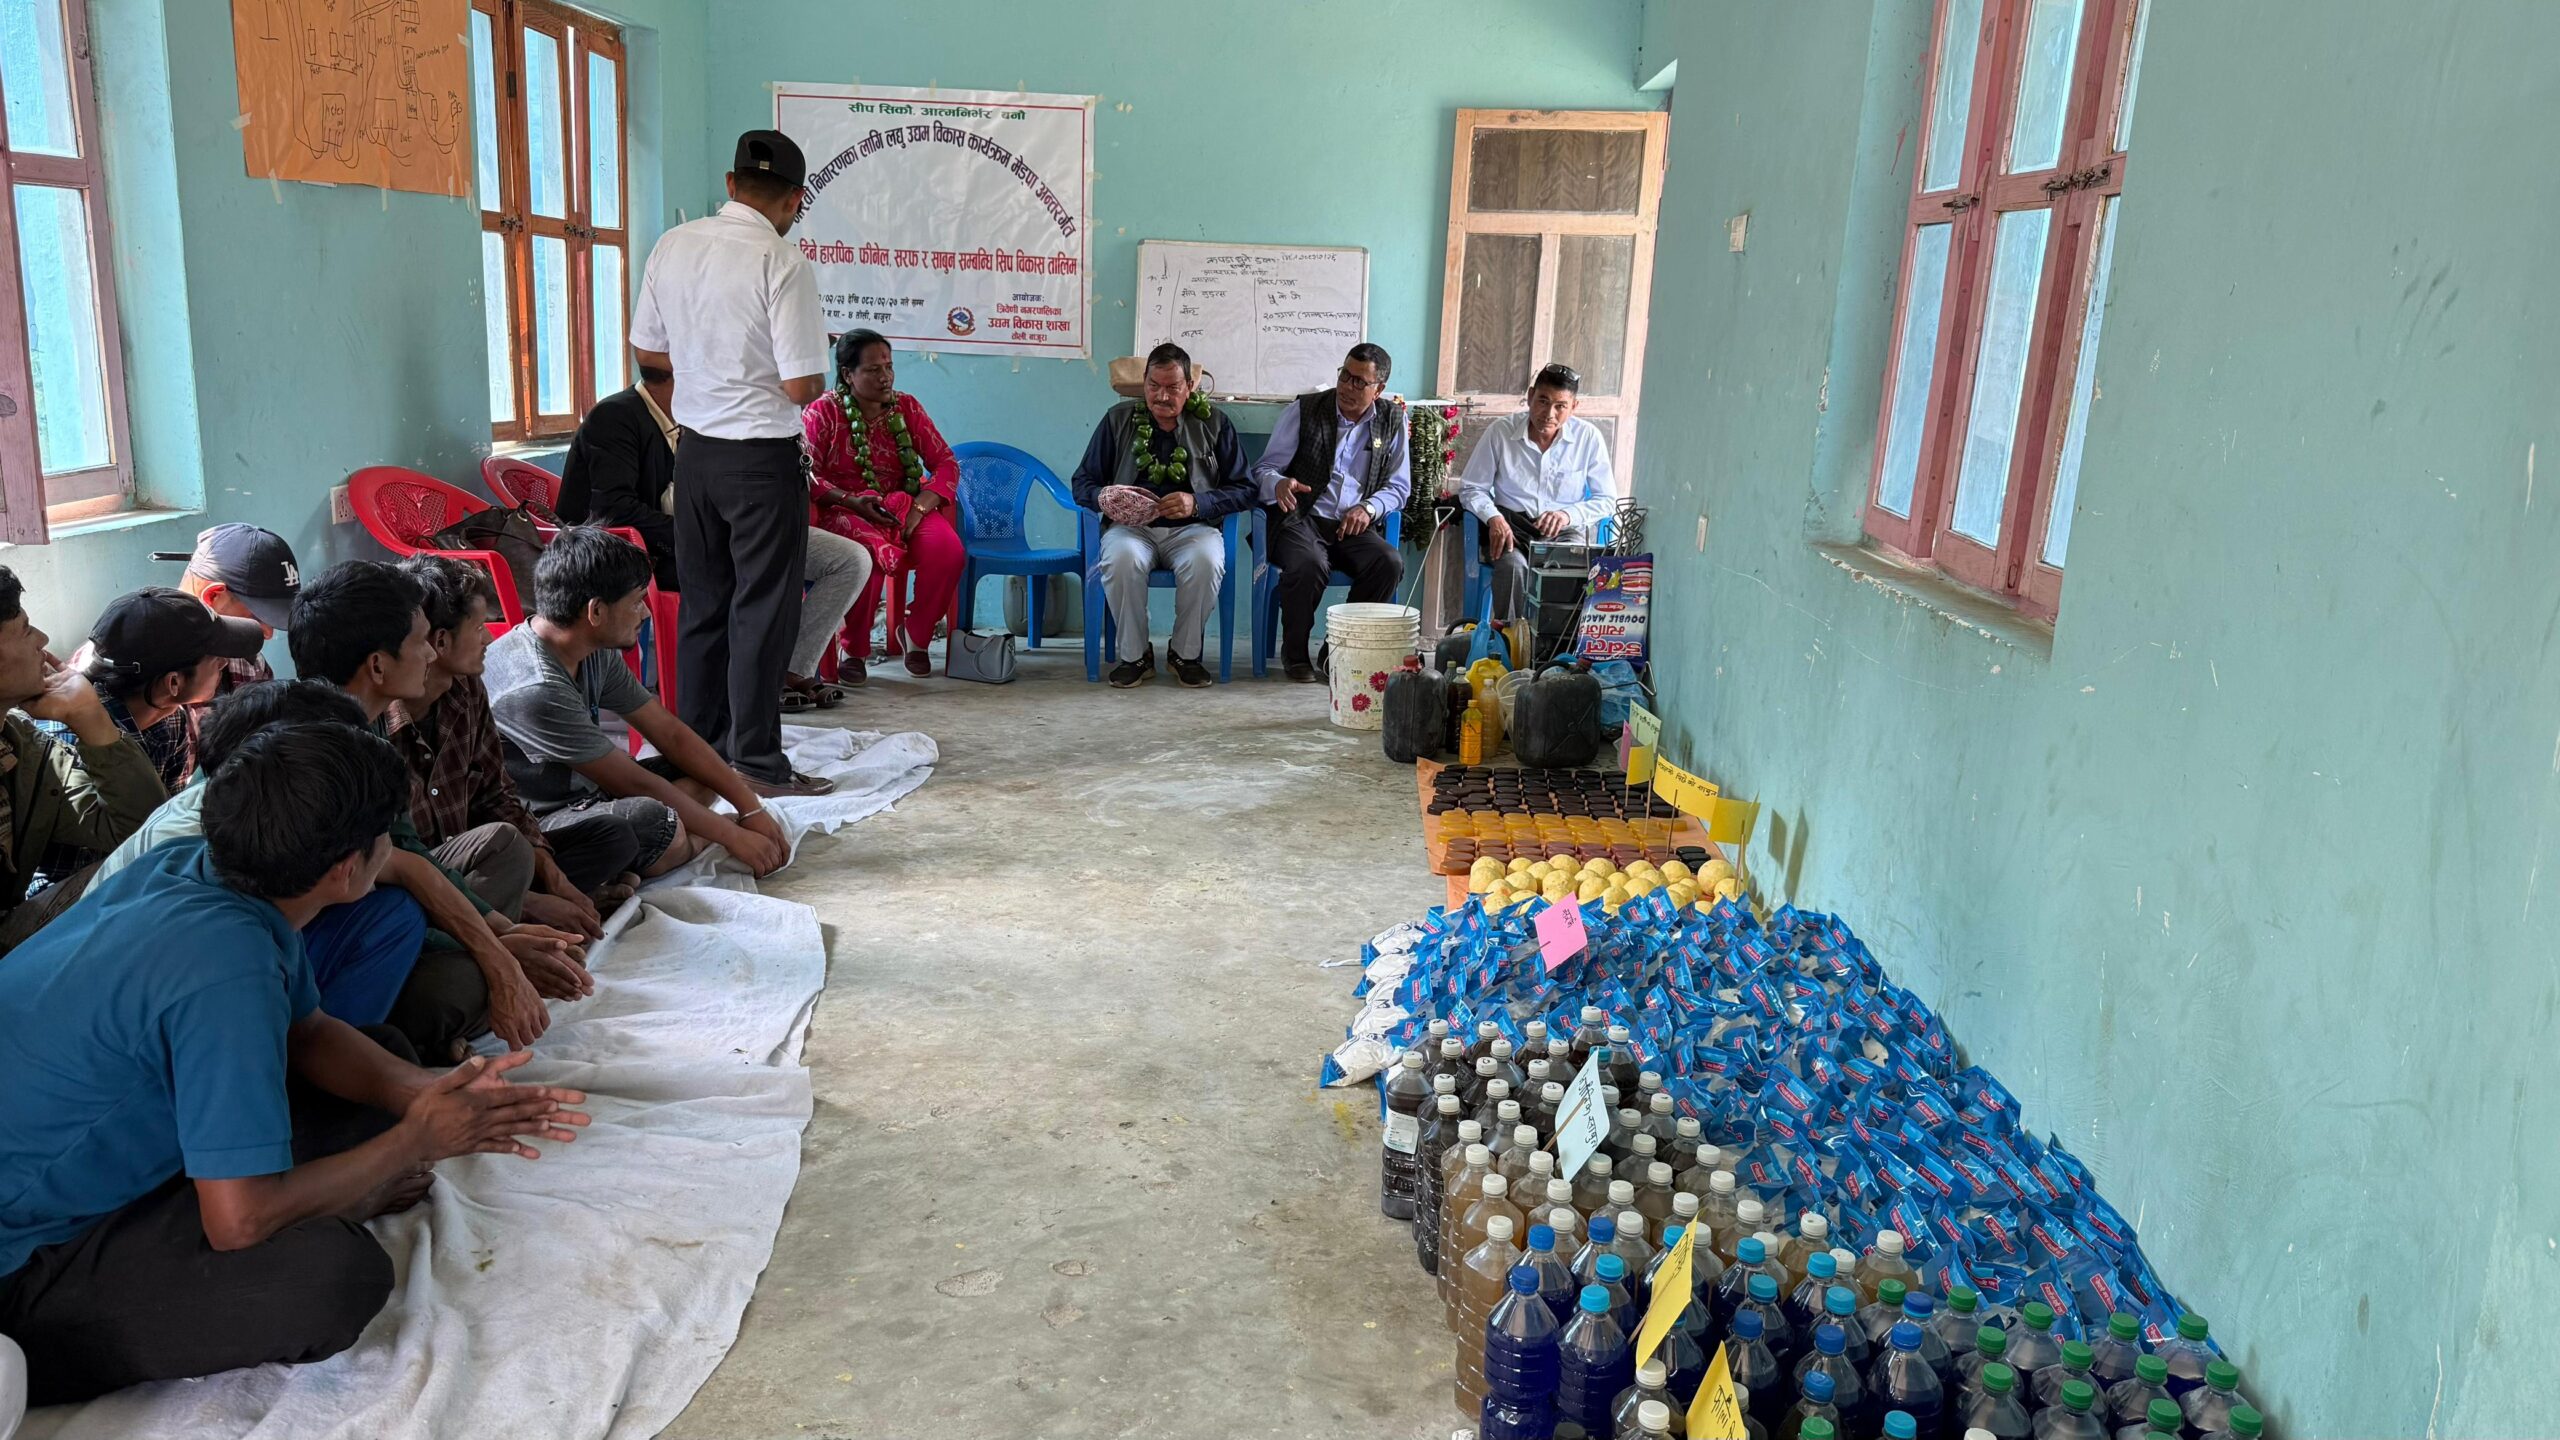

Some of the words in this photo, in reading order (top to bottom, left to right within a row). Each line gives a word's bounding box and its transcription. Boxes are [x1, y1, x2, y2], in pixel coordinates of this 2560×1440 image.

[848, 102, 875, 114] सीप
[920, 106, 993, 120] आत्मनिर्भर
[808, 145, 860, 194] निवारणका
[857, 129, 884, 157] लागि
[906, 125, 930, 143] उद्यम
[933, 120, 967, 148] विकास
[967, 132, 1013, 168] कार्यक्रम
[894, 249, 920, 268] सरफ
[922, 250, 929, 269] र
[931, 251, 956, 274] साबुन
[959, 247, 993, 272] सम्बन्धि
[996, 248, 1014, 273] सिप
[1016, 249, 1046, 275] विकास
[1048, 251, 1078, 275] तालिम
[847, 293, 860, 304] देखि
[996, 303, 1019, 314] त्रिवेणी
[1020, 304, 1062, 316] नगरपालिका
[988, 317, 1011, 329] उद्यम
[1013, 315, 1043, 330] विकास
[1046, 320, 1071, 332] शाखा
[281, 561, 300, 586] LA
[1608, 614, 1646, 624] DOUBLE
[1583, 639, 1642, 656] डबल
